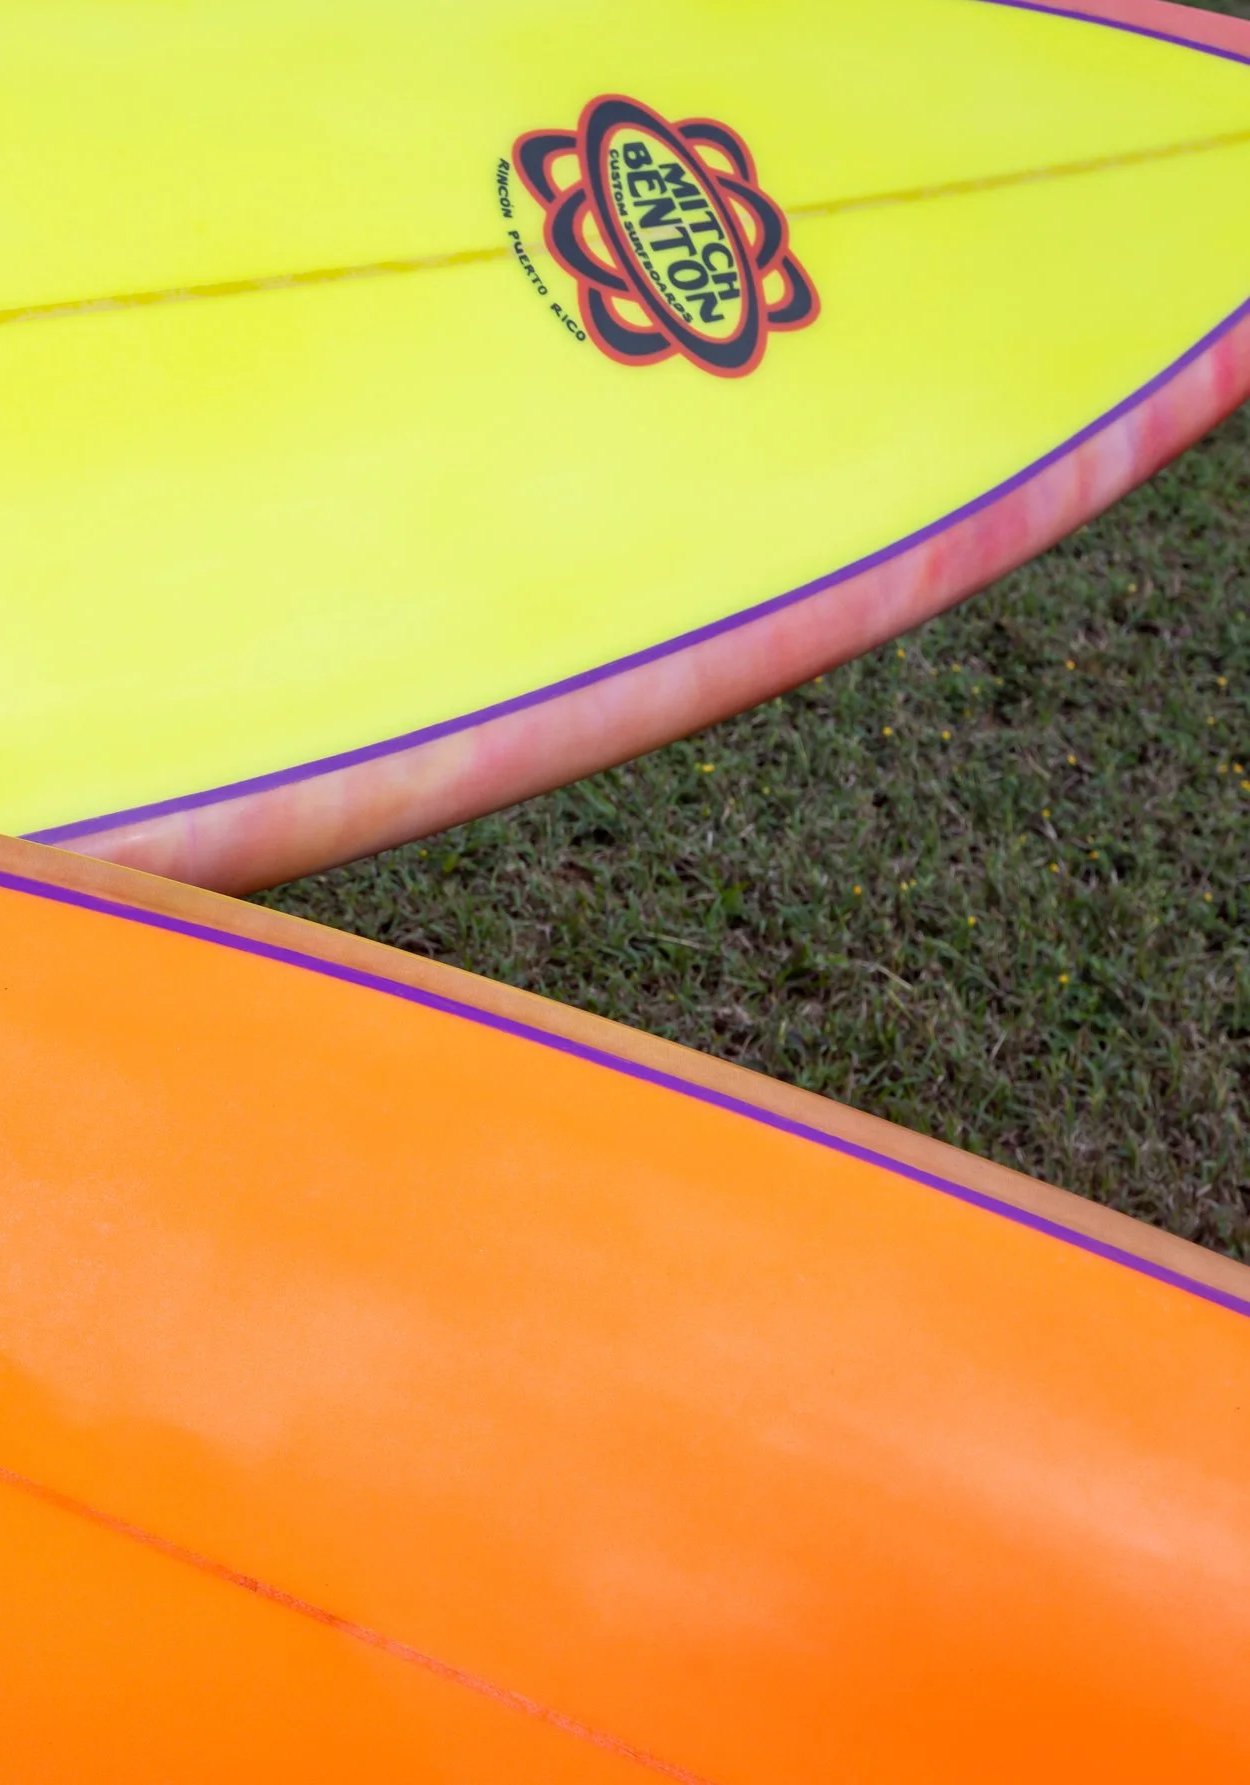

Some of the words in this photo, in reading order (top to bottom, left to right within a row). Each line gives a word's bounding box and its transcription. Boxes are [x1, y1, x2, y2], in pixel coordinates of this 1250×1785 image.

[495, 157, 513, 218] RINCÓN
[508, 229, 548, 296] PUERTO
[550, 302, 587, 342] RICO
[609, 148, 628, 217] CUSTOM
[623, 220, 694, 324] SURFBOARDS
[622, 141, 726, 324] BENTON
[658, 162, 741, 301] MITCH
